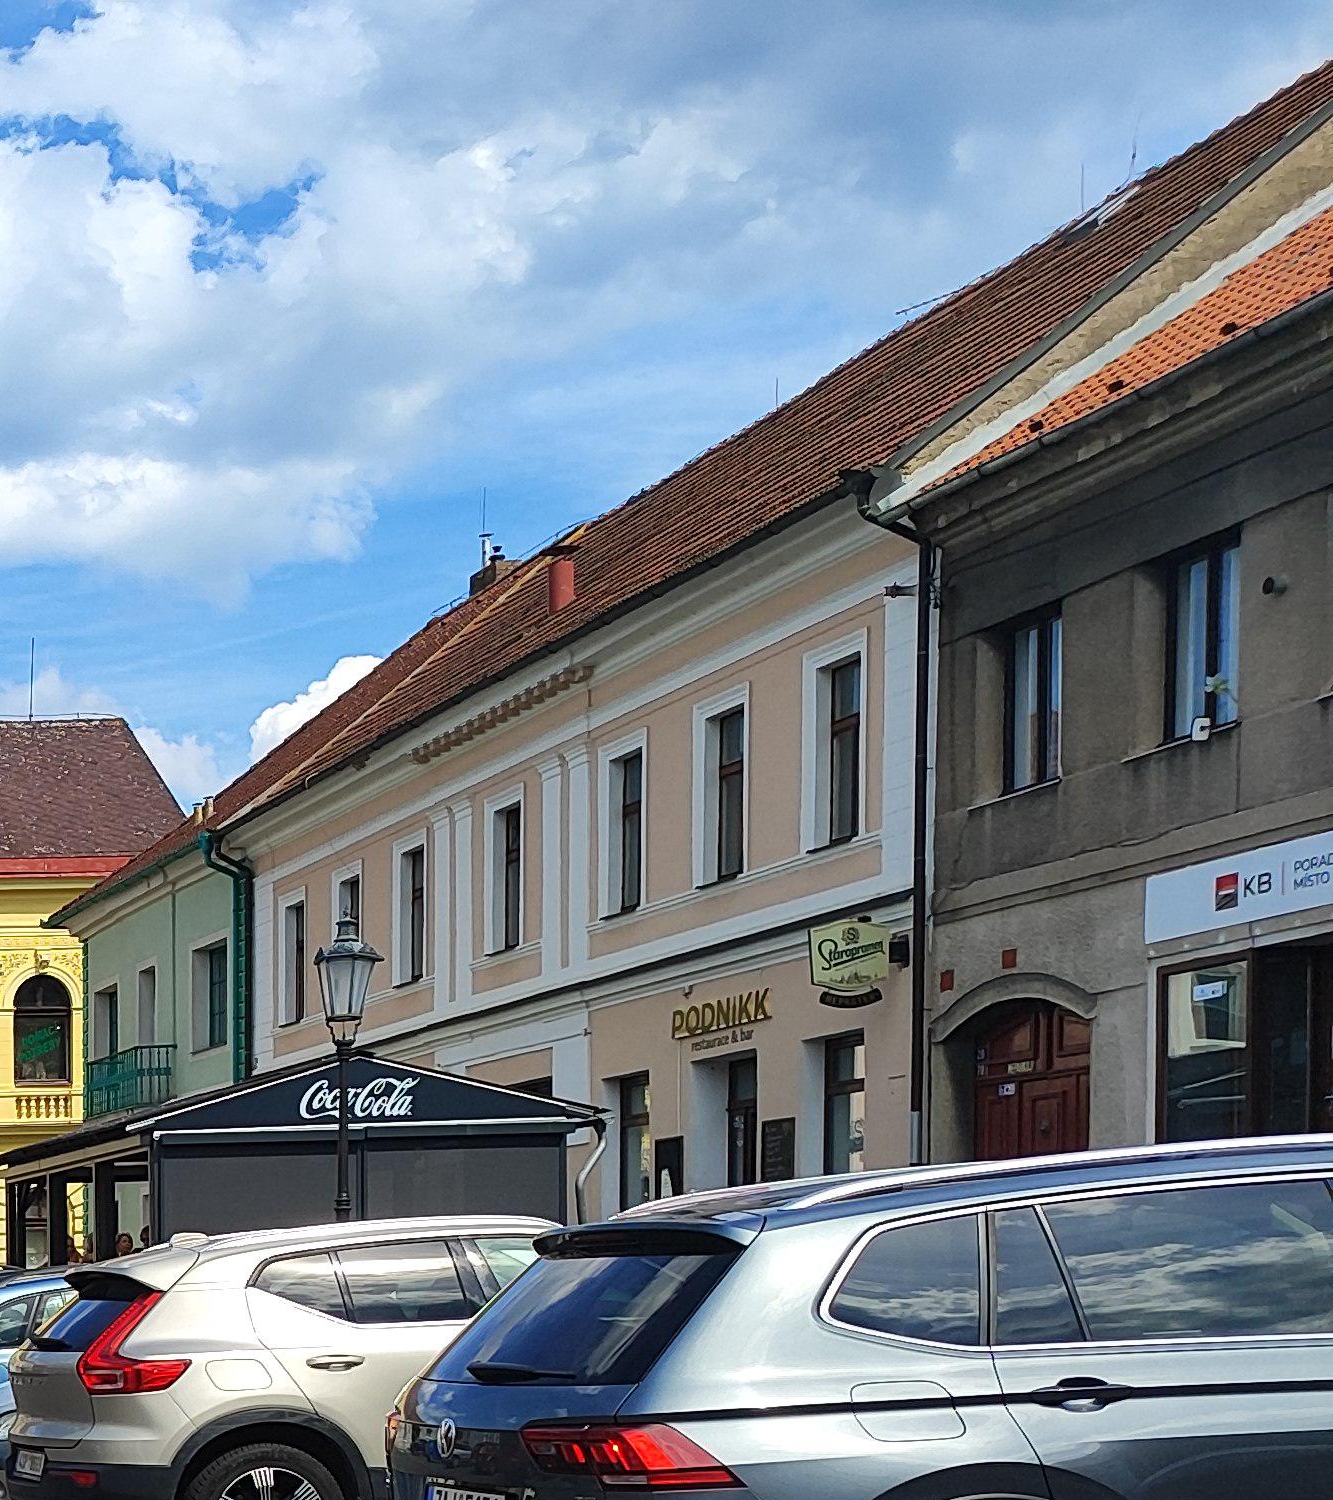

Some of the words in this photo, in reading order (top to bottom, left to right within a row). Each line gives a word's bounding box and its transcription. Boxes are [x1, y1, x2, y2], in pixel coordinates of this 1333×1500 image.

[1243, 871, 1272, 898] KB
[1294, 871, 1330, 890] MÍSTO
[672, 987, 770, 1039] PODNIKK
